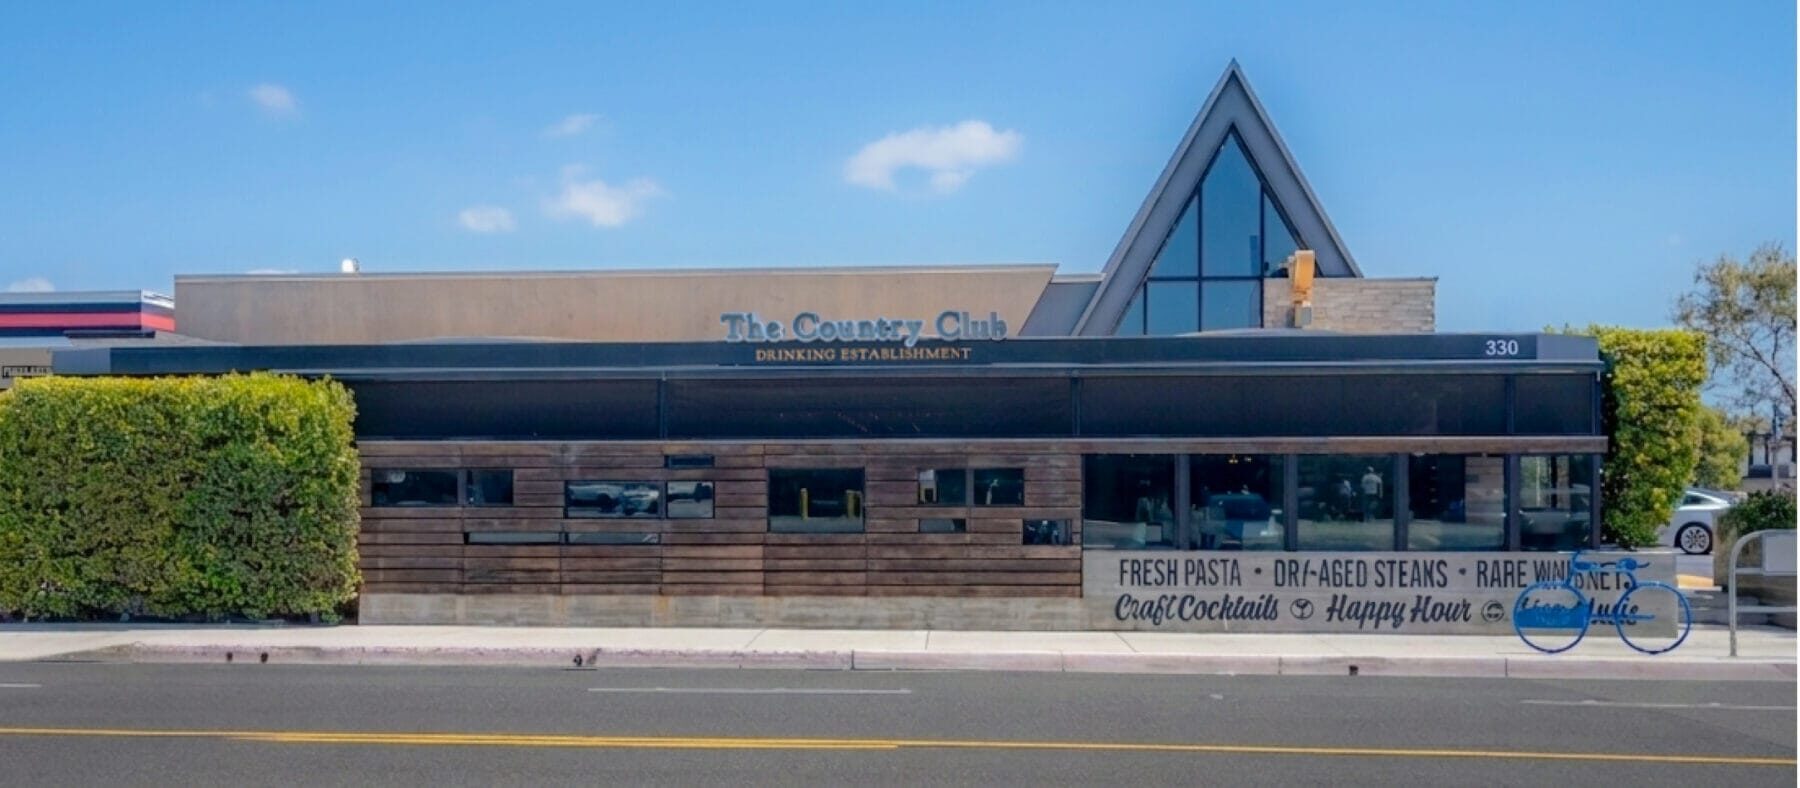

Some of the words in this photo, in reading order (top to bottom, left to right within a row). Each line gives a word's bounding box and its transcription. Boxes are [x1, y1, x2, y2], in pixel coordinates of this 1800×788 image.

[720, 312, 785, 342] The
[792, 311, 922, 347] Country
[935, 310, 1008, 341] Club
[755, 348, 836, 361] DRINKING
[840, 348, 972, 361] ESTABLISHMENT
[1485, 339, 1519, 356] 330
[1119, 558, 1178, 587] FRESH
[1184, 558, 1242, 587] PASTA
[1476, 559, 1527, 588] RARE
[1115, 593, 1176, 626] Craft
[1177, 594, 1278, 622] Cocktails
[1326, 594, 1406, 630] Happy
[1410, 595, 1472, 623] Hour
